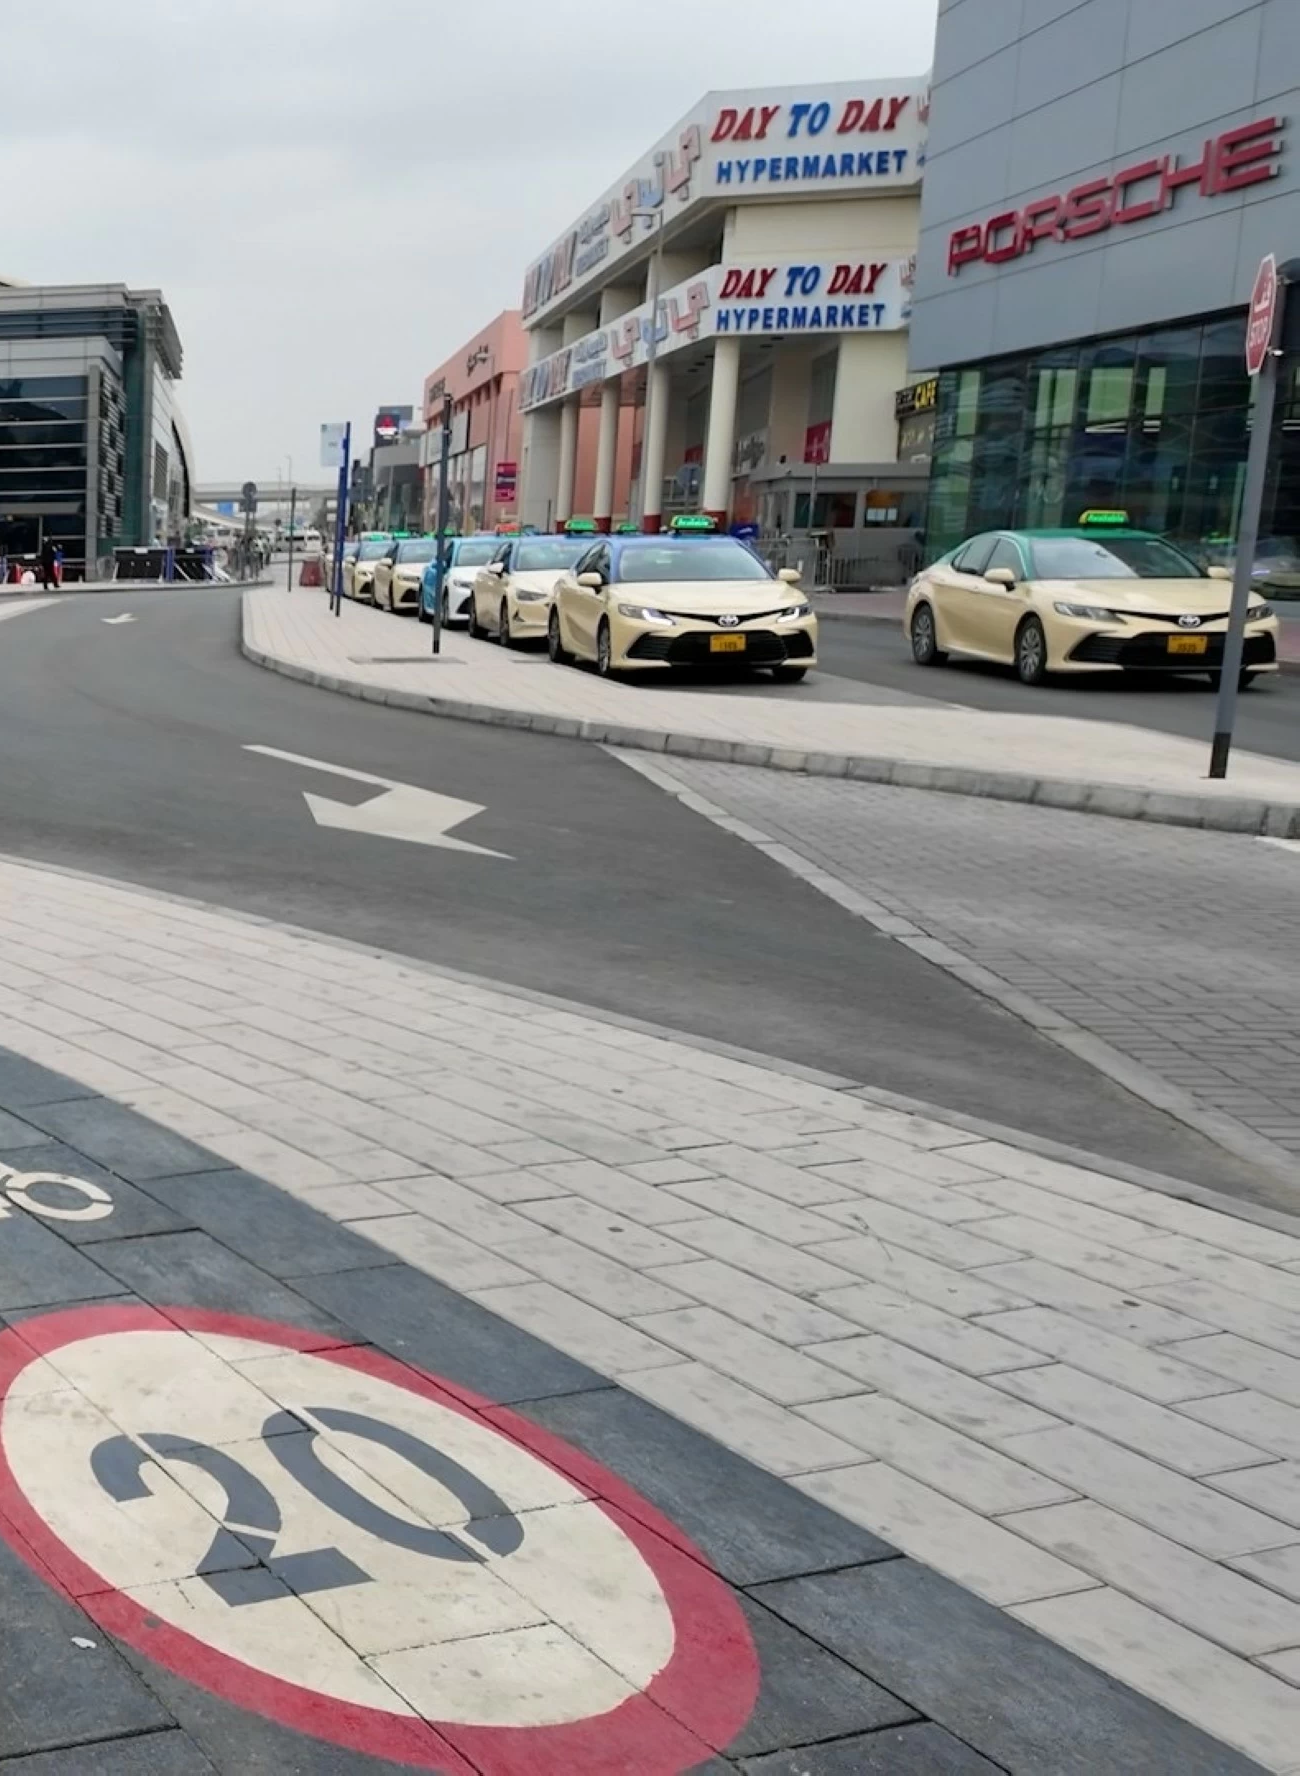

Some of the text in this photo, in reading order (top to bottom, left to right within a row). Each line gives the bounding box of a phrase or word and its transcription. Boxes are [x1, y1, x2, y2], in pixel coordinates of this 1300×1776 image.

[711, 104, 780, 143] DAY
[787, 101, 830, 138] TO
[837, 95, 910, 135] DAY
[716, 149, 908, 184] HYPERMARKET
[948, 116, 1286, 278] PORSCHE
[720, 267, 777, 299] DAY
[784, 265, 820, 297] TO
[827, 263, 888, 295] DAY
[716, 303, 886, 332] HYPERMARKET
[1249, 316, 1269, 347] STOP
[90, 1406, 525, 1609] 20
